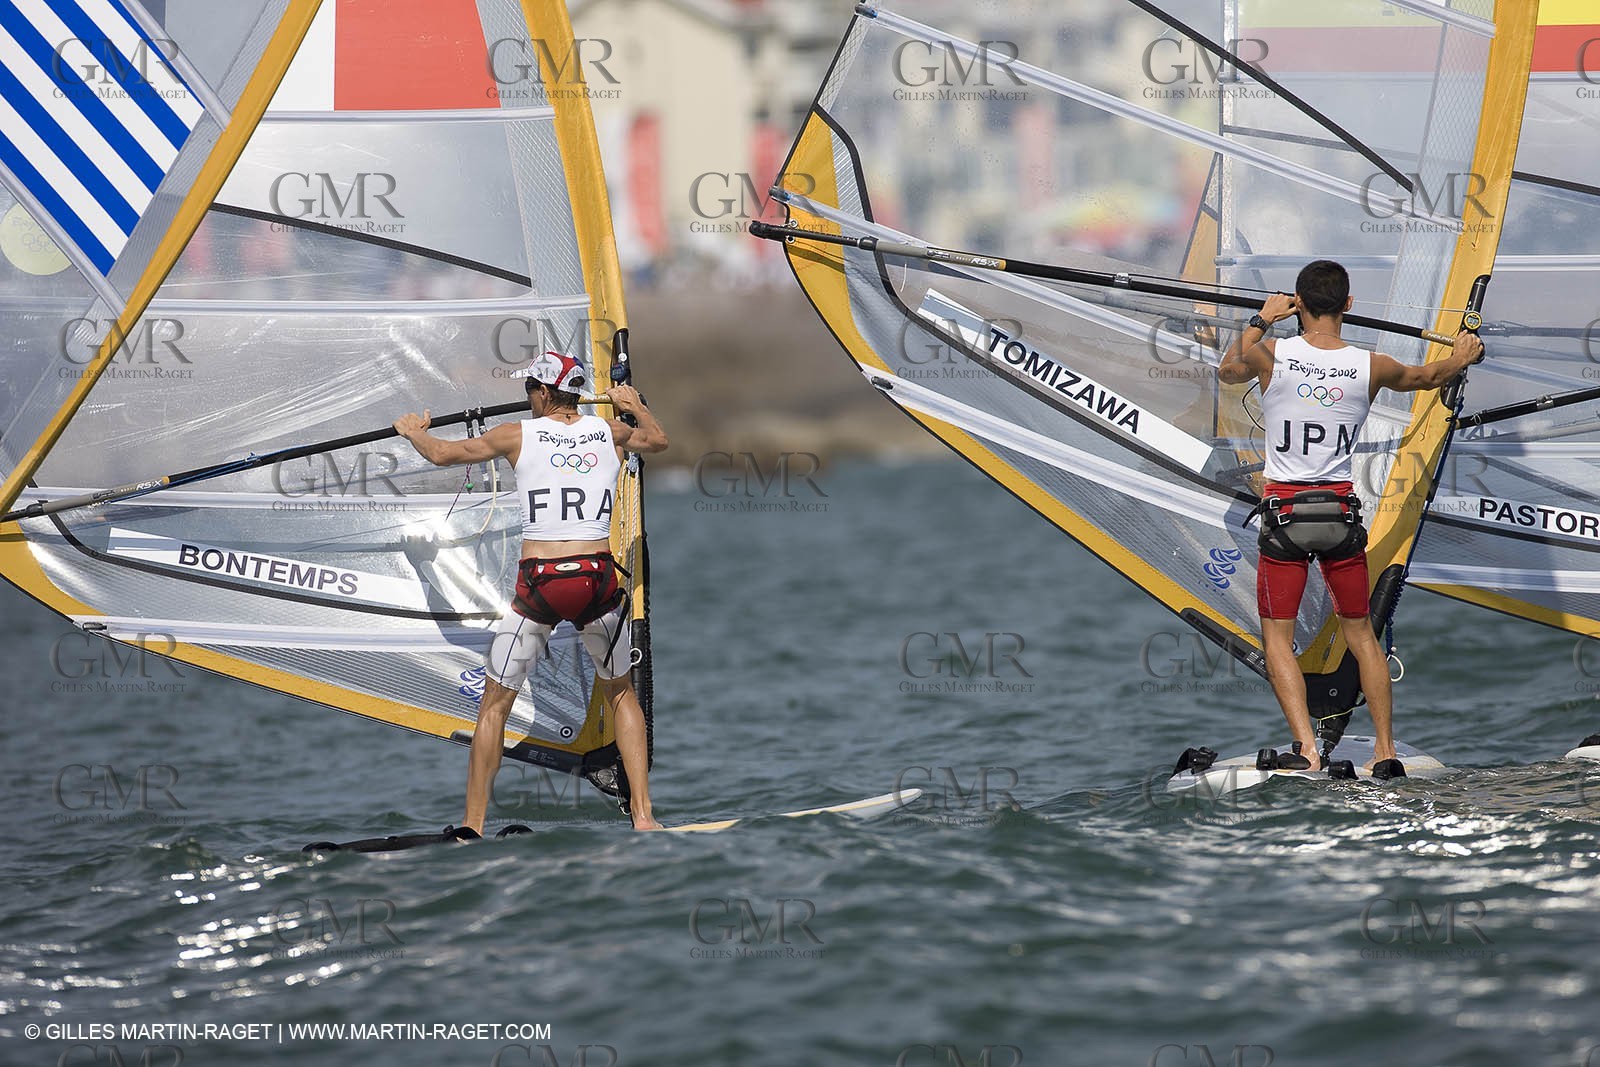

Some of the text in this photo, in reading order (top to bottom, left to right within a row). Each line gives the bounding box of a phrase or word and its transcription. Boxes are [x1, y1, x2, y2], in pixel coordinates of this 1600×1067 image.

[988, 327, 1141, 435] TOMIZAWA
[1287, 358, 1358, 381] Beijing 2008
[536, 430, 607, 449] Beijing 2008
[1275, 419, 1358, 457] JPN
[527, 487, 613, 524] FRA
[1479, 498, 1600, 538] PASTOR
[178, 543, 359, 596] BONTEMPS
